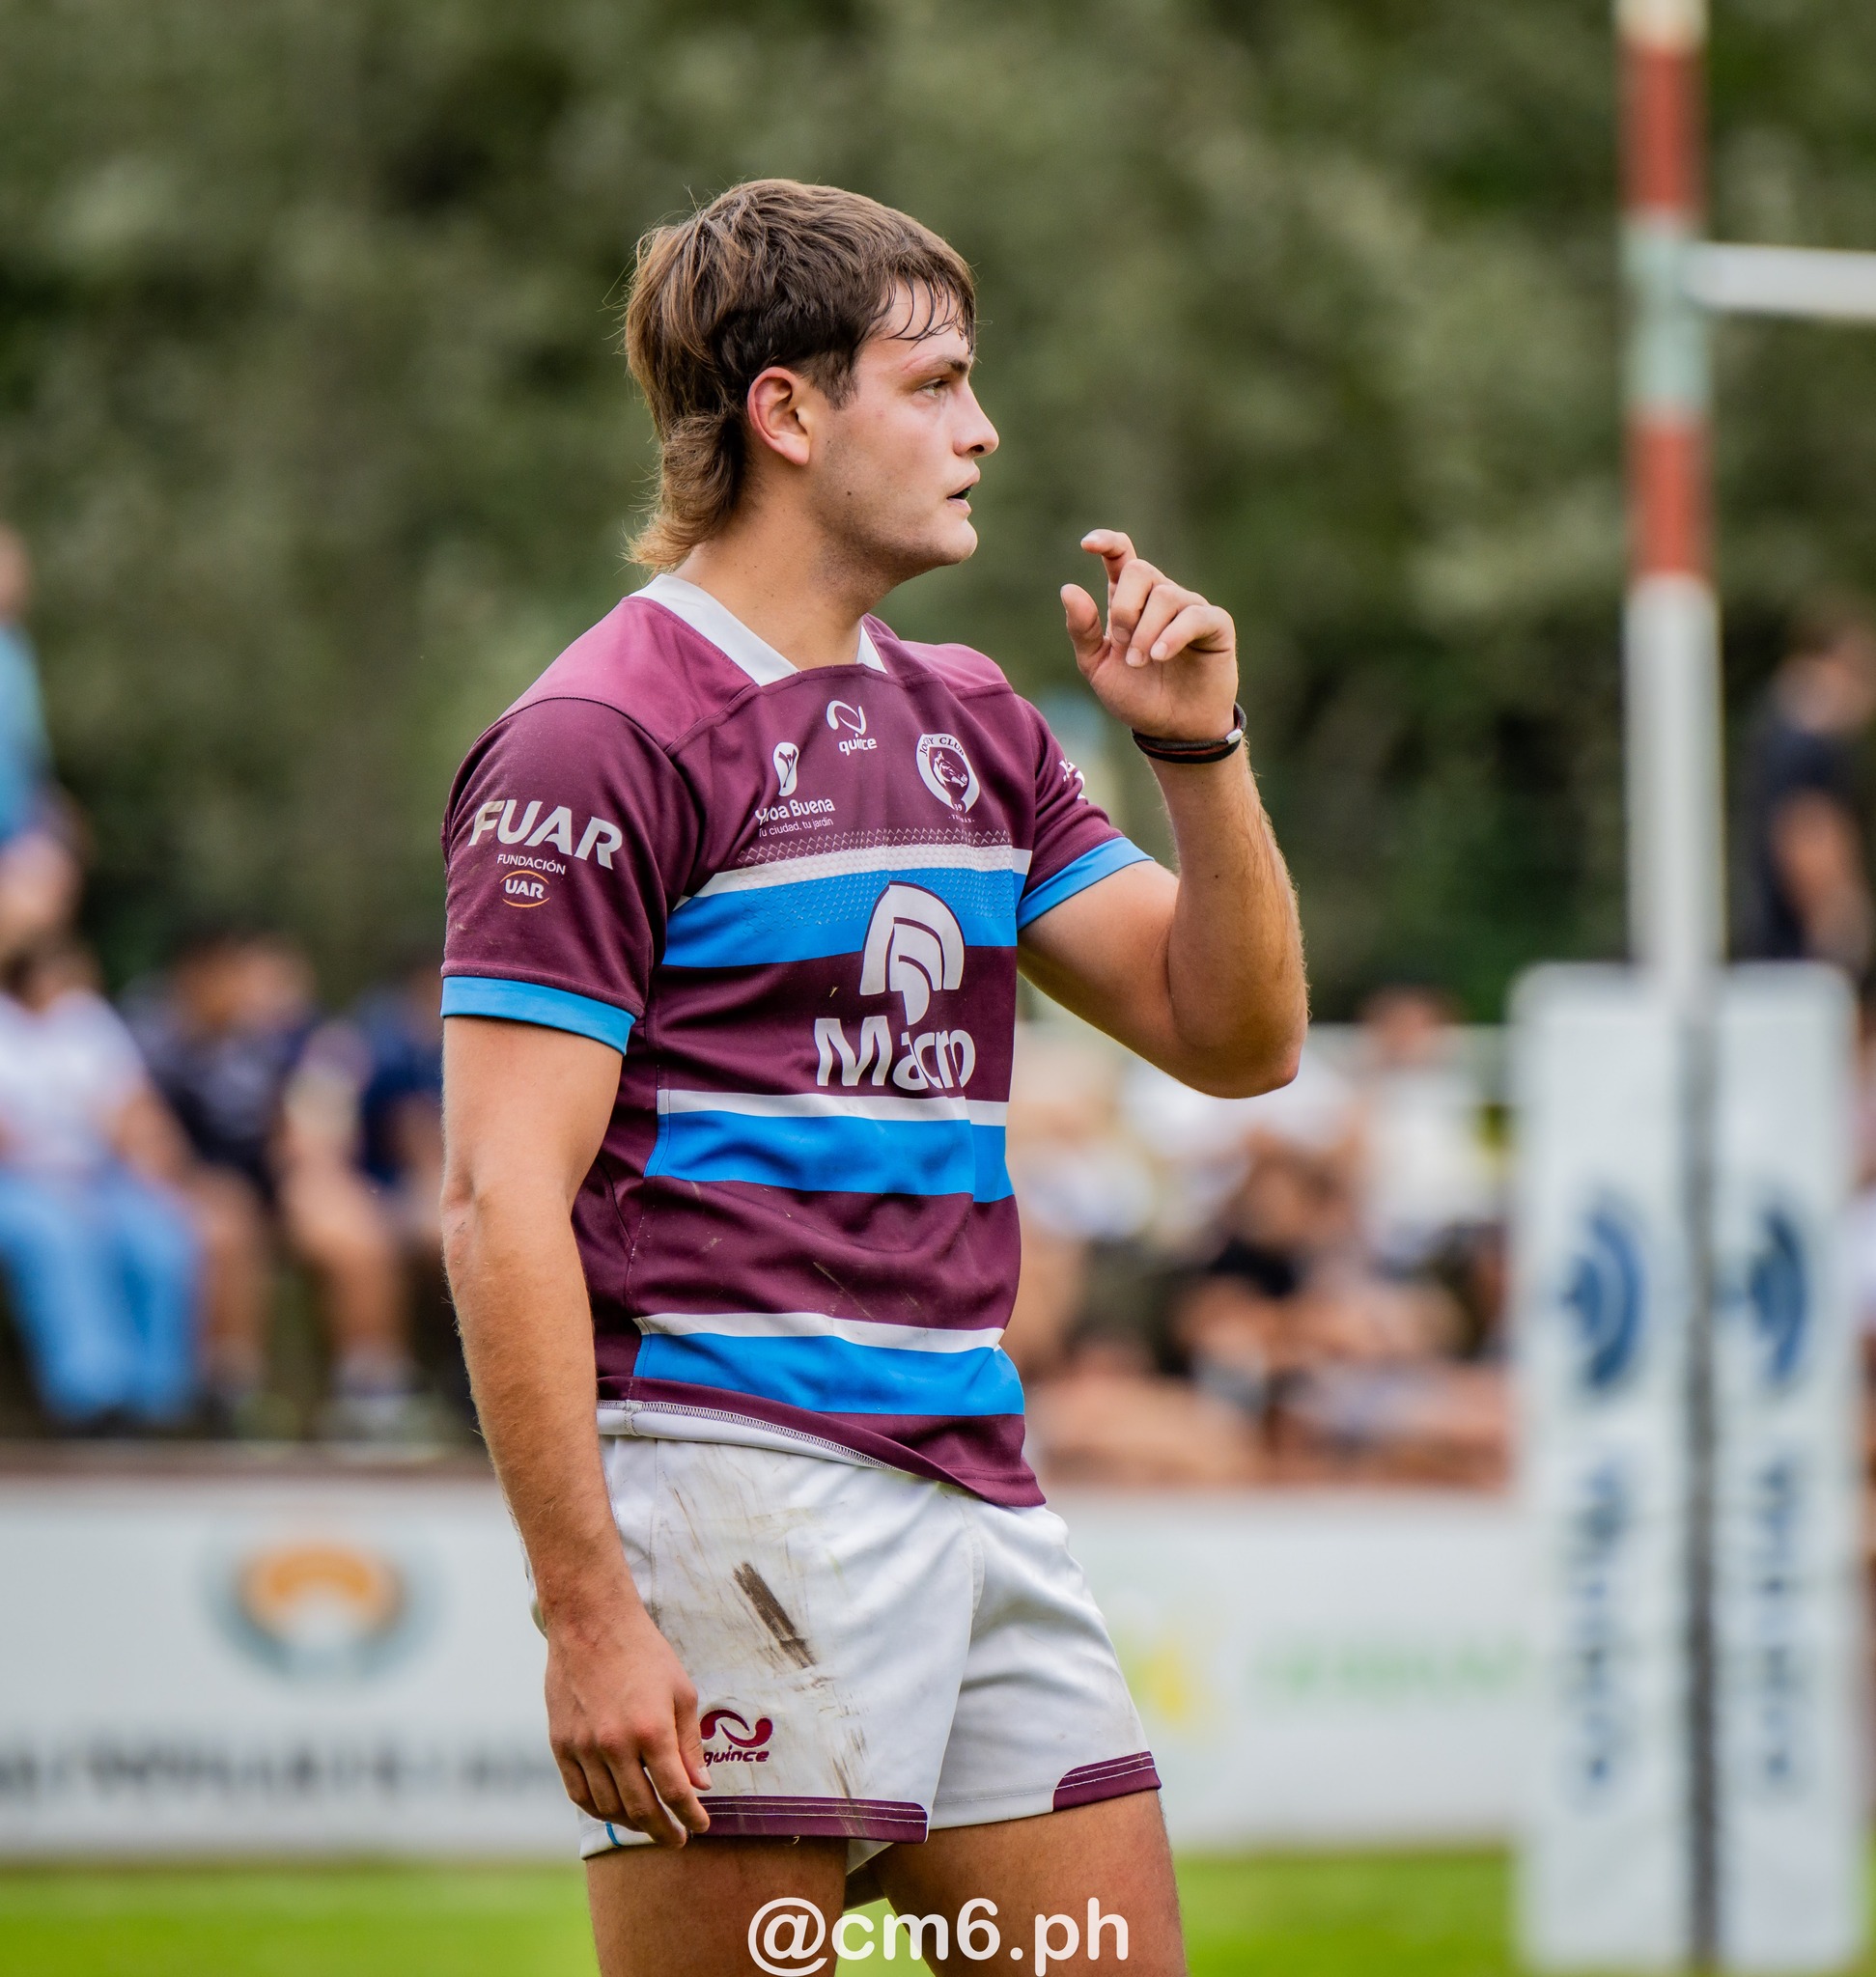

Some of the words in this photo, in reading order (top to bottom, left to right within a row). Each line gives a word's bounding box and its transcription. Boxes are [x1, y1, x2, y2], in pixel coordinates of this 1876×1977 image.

[789, 798, 836, 817] Buena
[467, 799, 623, 870] FUAR
[769, 821, 802, 836] ciudad,
[802, 821, 812, 829] tu
[496, 853, 566, 876] FUNDACIÓN
[505, 878, 545, 899] UAR
[814, 1016, 976, 1091] Macro
[703, 1744, 770, 1768] quince
